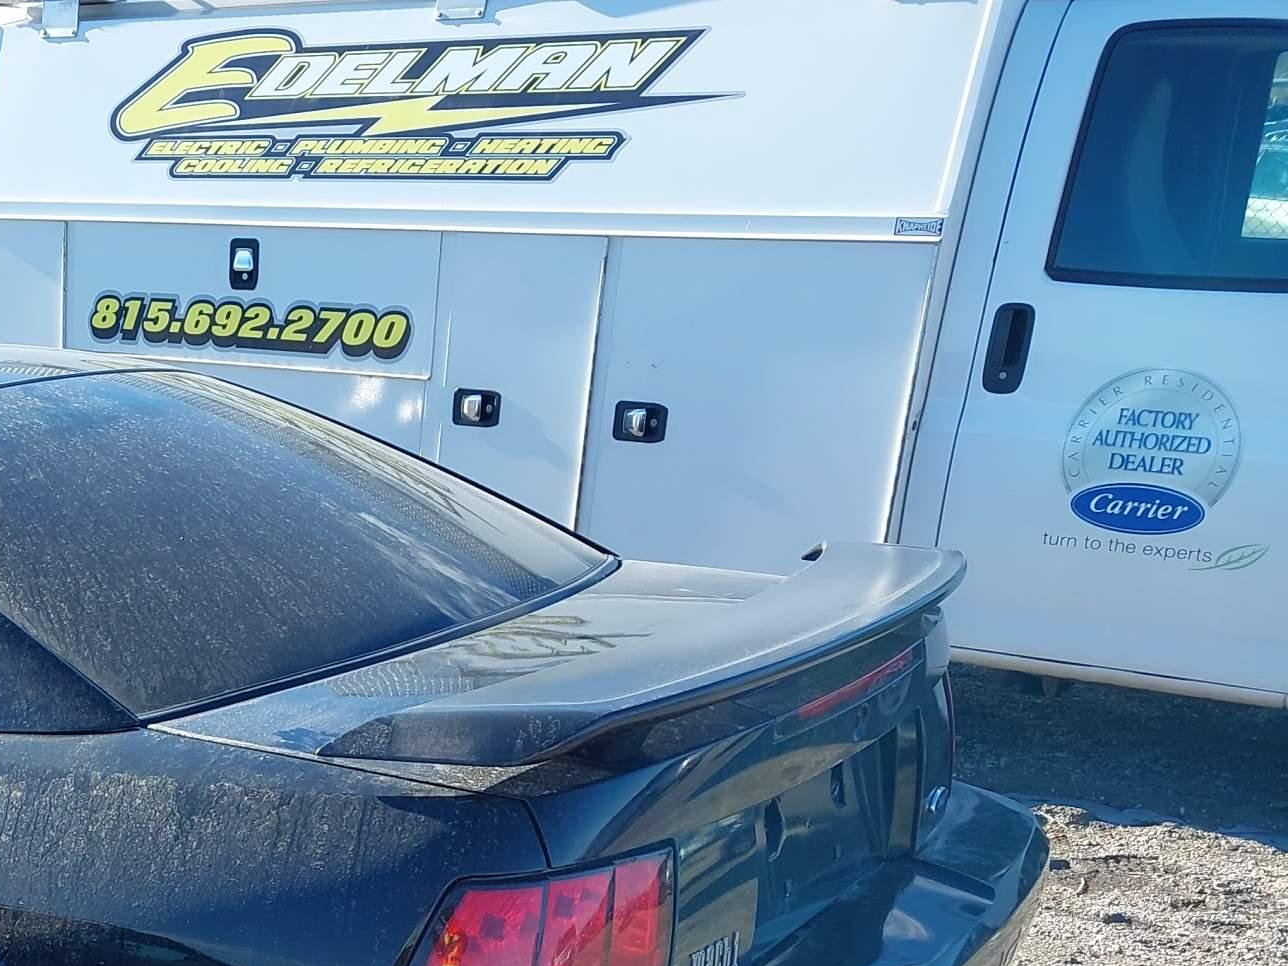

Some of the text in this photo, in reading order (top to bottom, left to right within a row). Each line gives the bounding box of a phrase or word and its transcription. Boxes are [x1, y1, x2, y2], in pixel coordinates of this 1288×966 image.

[119, 35, 681, 133] EDELMAN
[152, 137, 616, 155] ELECTRIC PLUMBING HEATING
[180, 157, 560, 174] COOLING REFRIGERATION
[90, 296, 408, 348] 815.692.2700
[1068, 374, 1236, 488] CARRIER RESIDENTIAL
[1116, 408, 1200, 431] FACTORY
[1092, 430, 1212, 454] AUTHORIZED
[1108, 452, 1184, 476] DEALER
[1089, 493, 1188, 520] Carrier
[1042, 532, 1213, 563] turn to the experts
